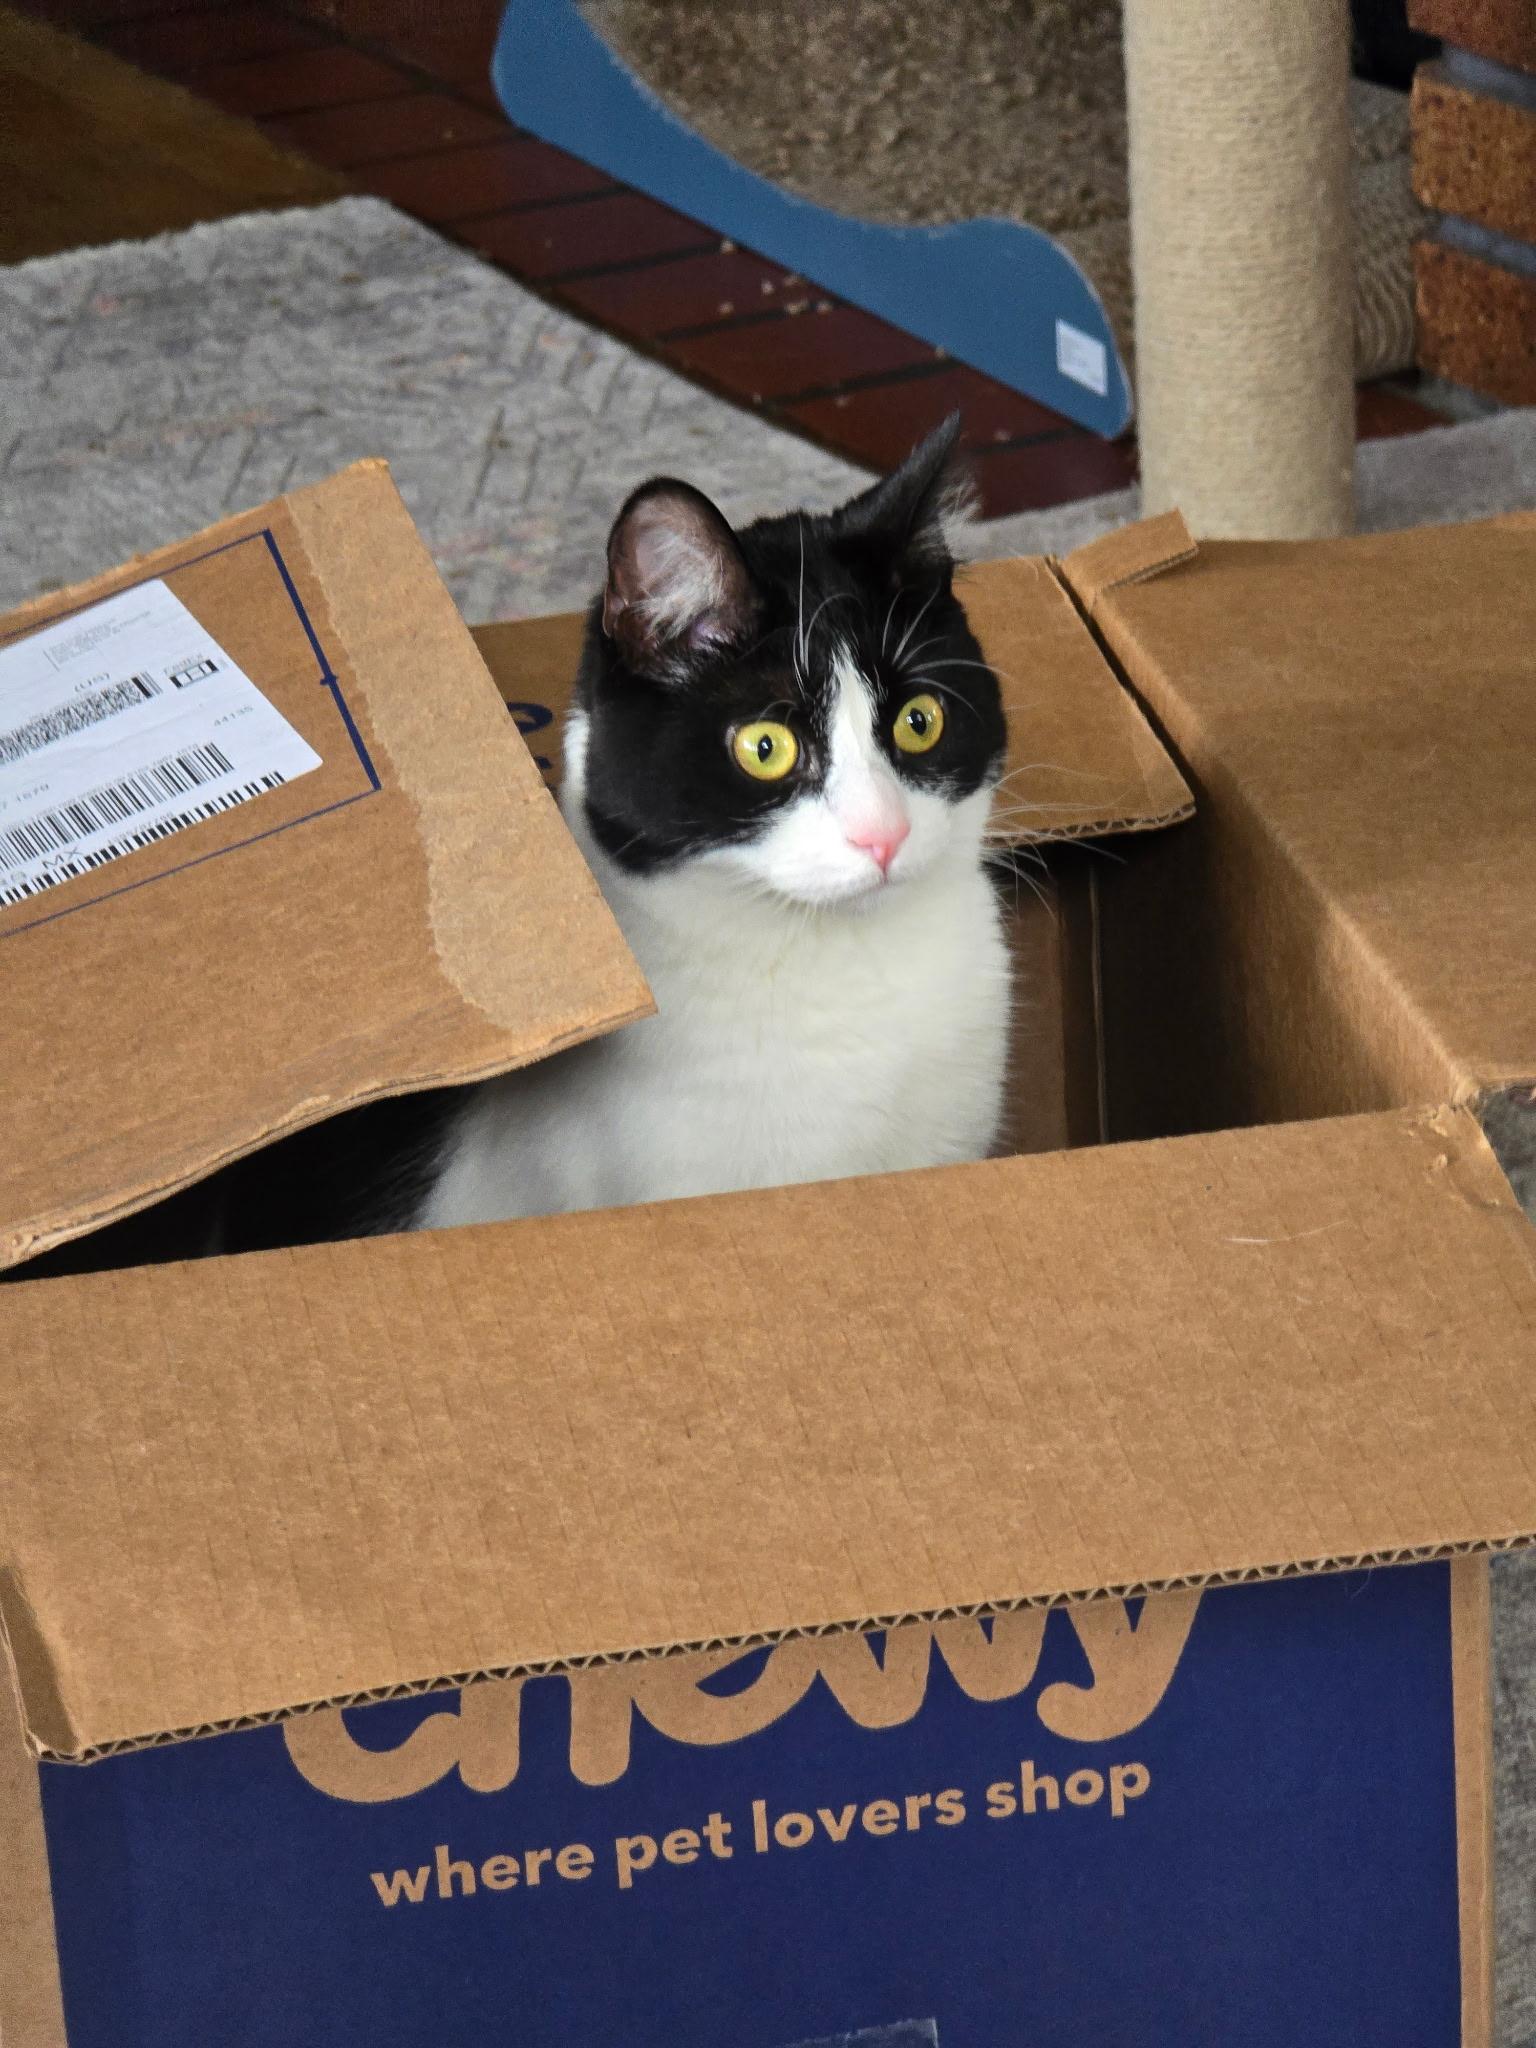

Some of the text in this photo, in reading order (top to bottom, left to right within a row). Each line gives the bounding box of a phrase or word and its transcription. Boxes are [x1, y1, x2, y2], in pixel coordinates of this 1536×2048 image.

[42, 846, 83, 869] MX
[370, 1760, 1151, 1907] where pet lovers shop
